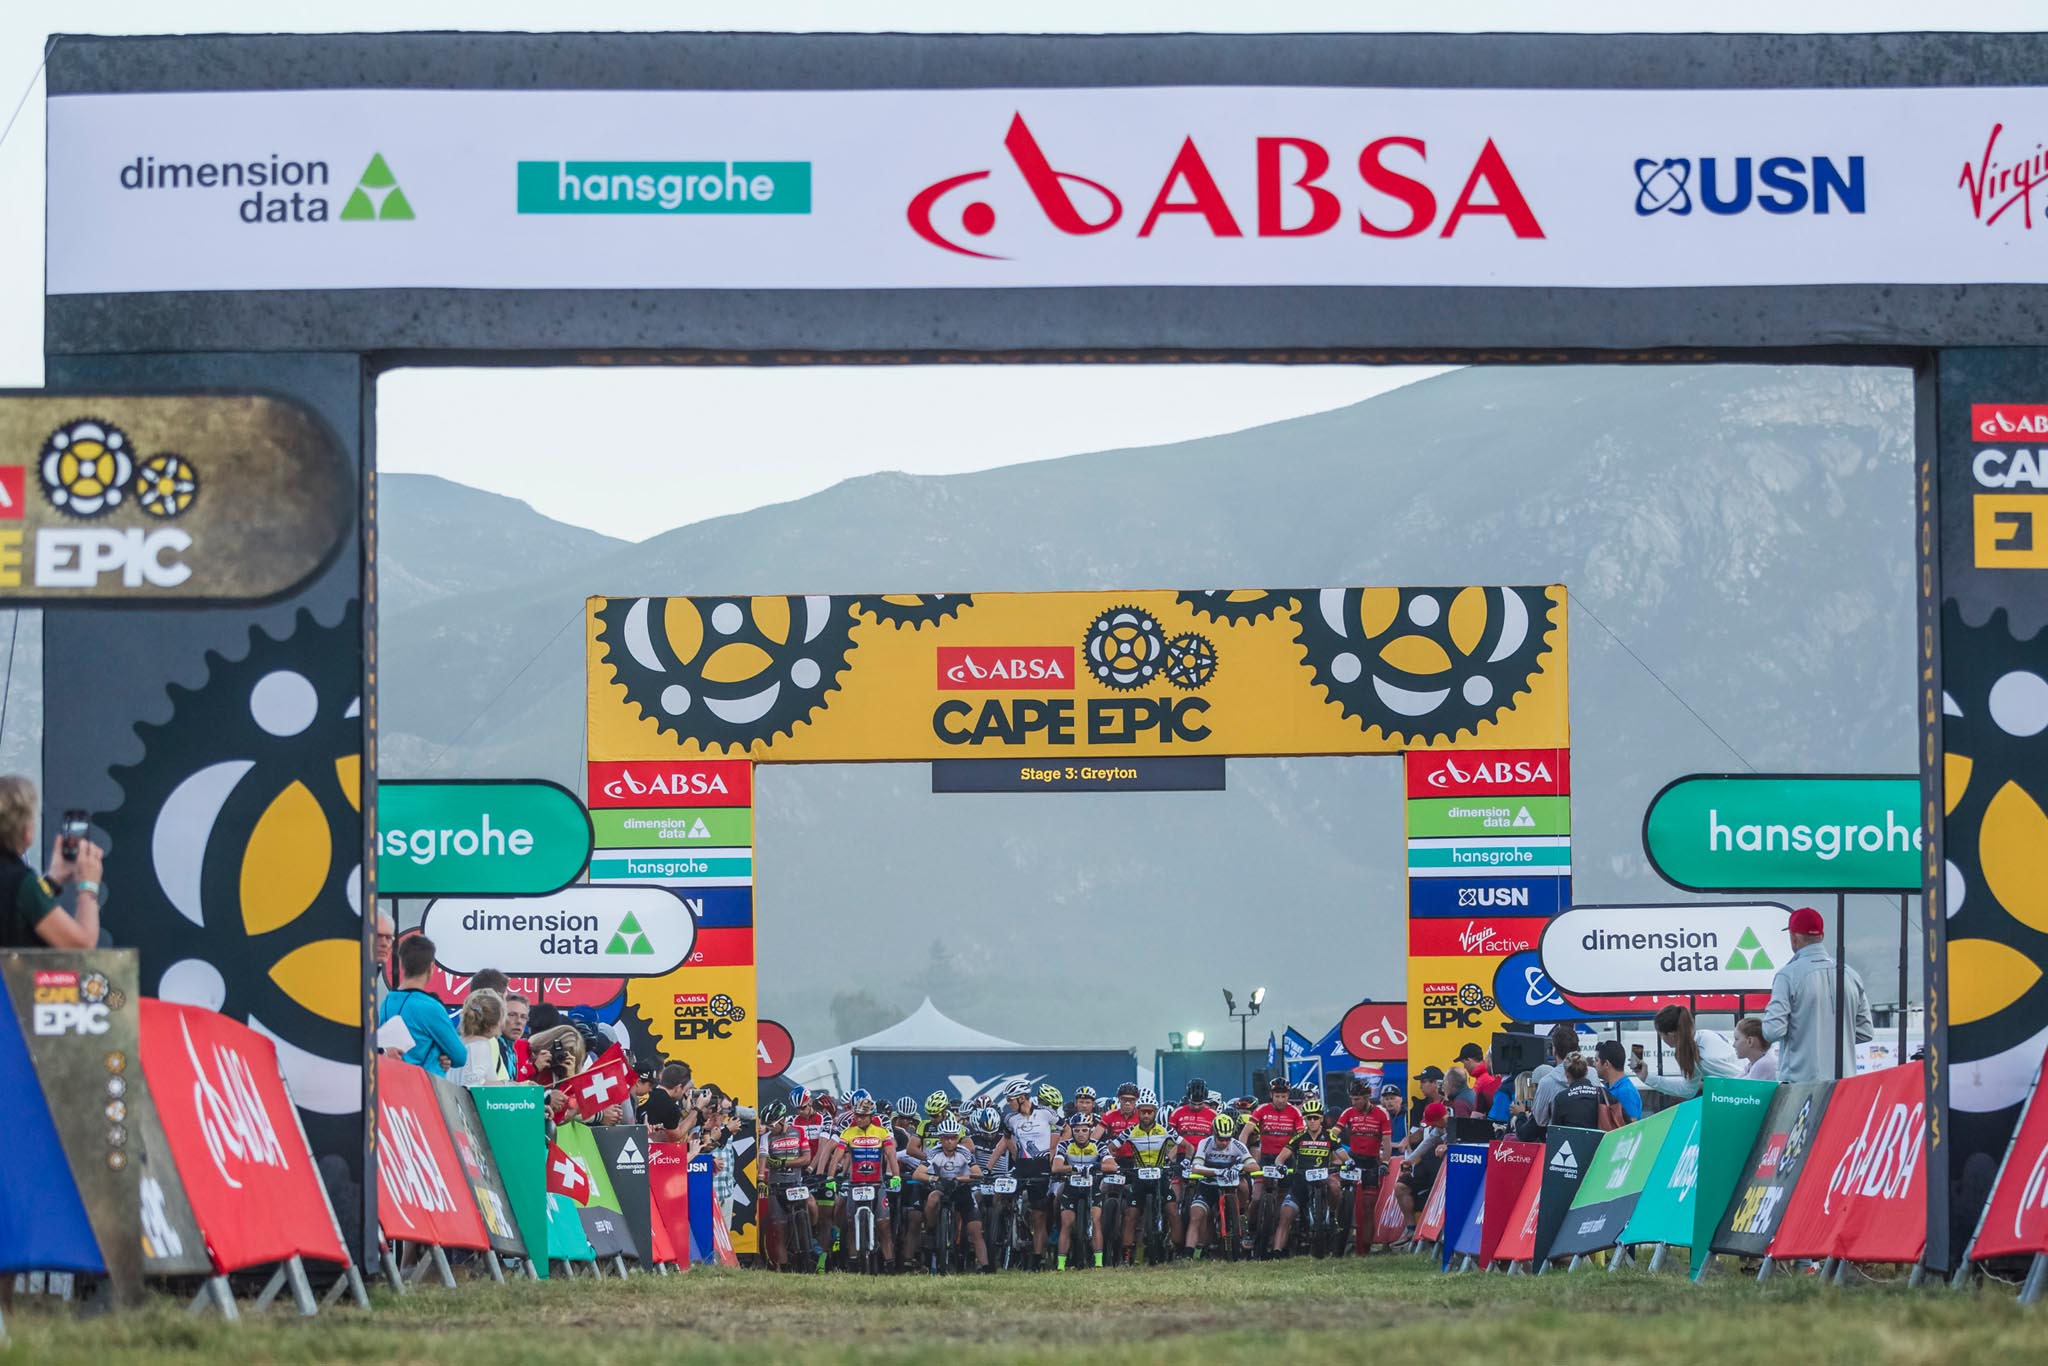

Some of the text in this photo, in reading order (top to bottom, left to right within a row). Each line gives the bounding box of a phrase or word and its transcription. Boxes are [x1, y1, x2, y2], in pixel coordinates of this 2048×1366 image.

[119, 154, 329, 190] dimension
[557, 161, 775, 210] hansgrohe
[1137, 134, 1547, 239] ABSA
[1699, 155, 1867, 215] USN
[239, 192, 329, 224] data
[34, 527, 193, 588] EPIC
[988, 658, 1065, 680] ABSA
[932, 696, 1213, 745] CAPE EPIC
[1020, 766, 1138, 782] Stage 3: Greyton
[1472, 761, 1553, 784] ABSA
[648, 773, 729, 795] ABSA
[1447, 806, 1511, 818] dimension
[1482, 816, 1511, 828] data
[623, 817, 686, 830] dimension
[658, 827, 686, 840] data
[1452, 846, 1533, 865] hansgrohe
[627, 858, 708, 877] hansgrohe
[1477, 887, 1529, 906] USN
[461, 909, 599, 931] dimension
[540, 933, 599, 955] data
[1458, 920, 1497, 954] Virgin
[1485, 937, 1530, 952] active
[1581, 927, 1719, 951] dimension
[1660, 951, 1720, 973] data
[674, 1006, 708, 1017] CAPE
[1423, 995, 1458, 1007] CAPE
[34, 1003, 110, 1036] EPIC
[674, 1018, 732, 1040] EPIC
[1423, 1006, 1483, 1030] EPIC
[486, 1100, 536, 1112] hansgrohe
[1711, 1091, 1761, 1106] hansgrohe
[657, 1155, 680, 1165] active
[1459, 1152, 1482, 1165] USN
[1506, 1153, 1532, 1164] active
[1563, 1171, 1578, 1180] data
